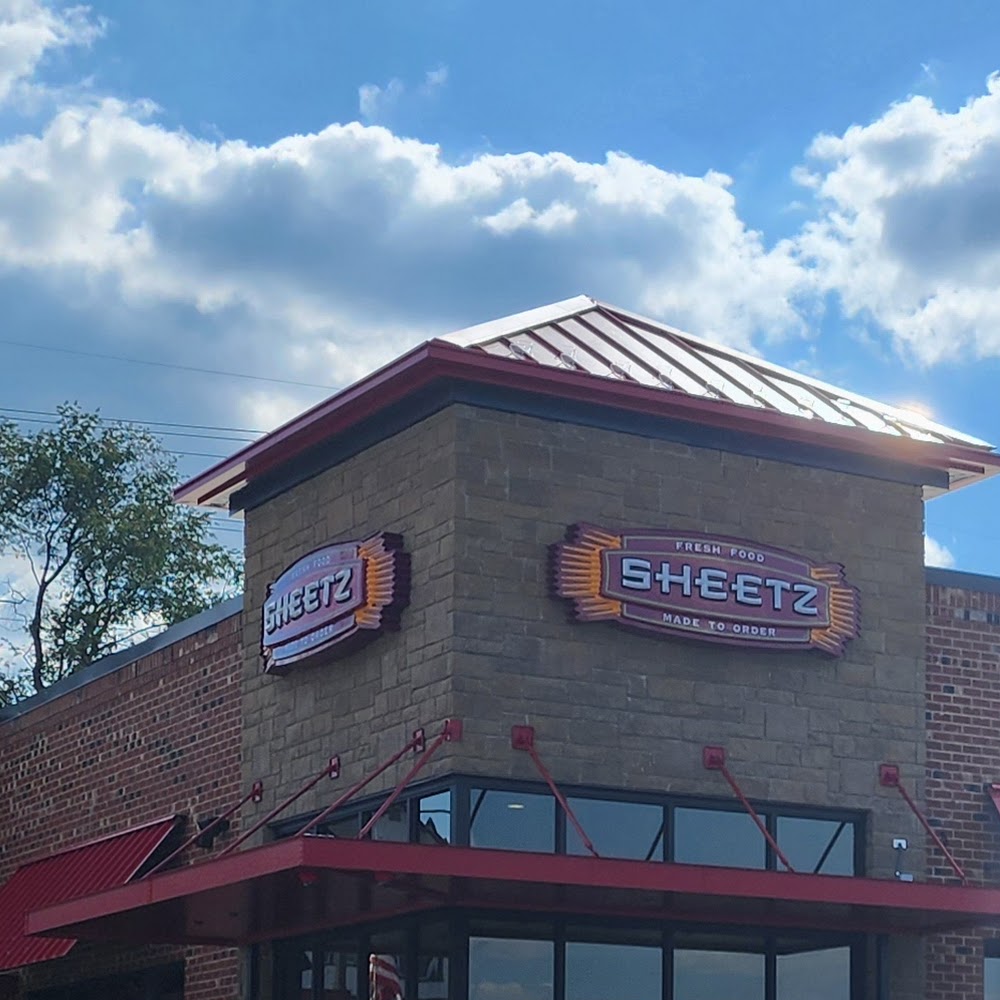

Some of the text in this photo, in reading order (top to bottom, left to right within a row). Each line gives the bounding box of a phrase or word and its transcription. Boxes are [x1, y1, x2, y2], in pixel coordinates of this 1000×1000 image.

[675, 541, 766, 563] FRESH FOOD
[264, 568, 353, 635] SHEETZ
[621, 557, 819, 616] SHEETZ
[662, 612, 777, 638] MADE TO ORDER
